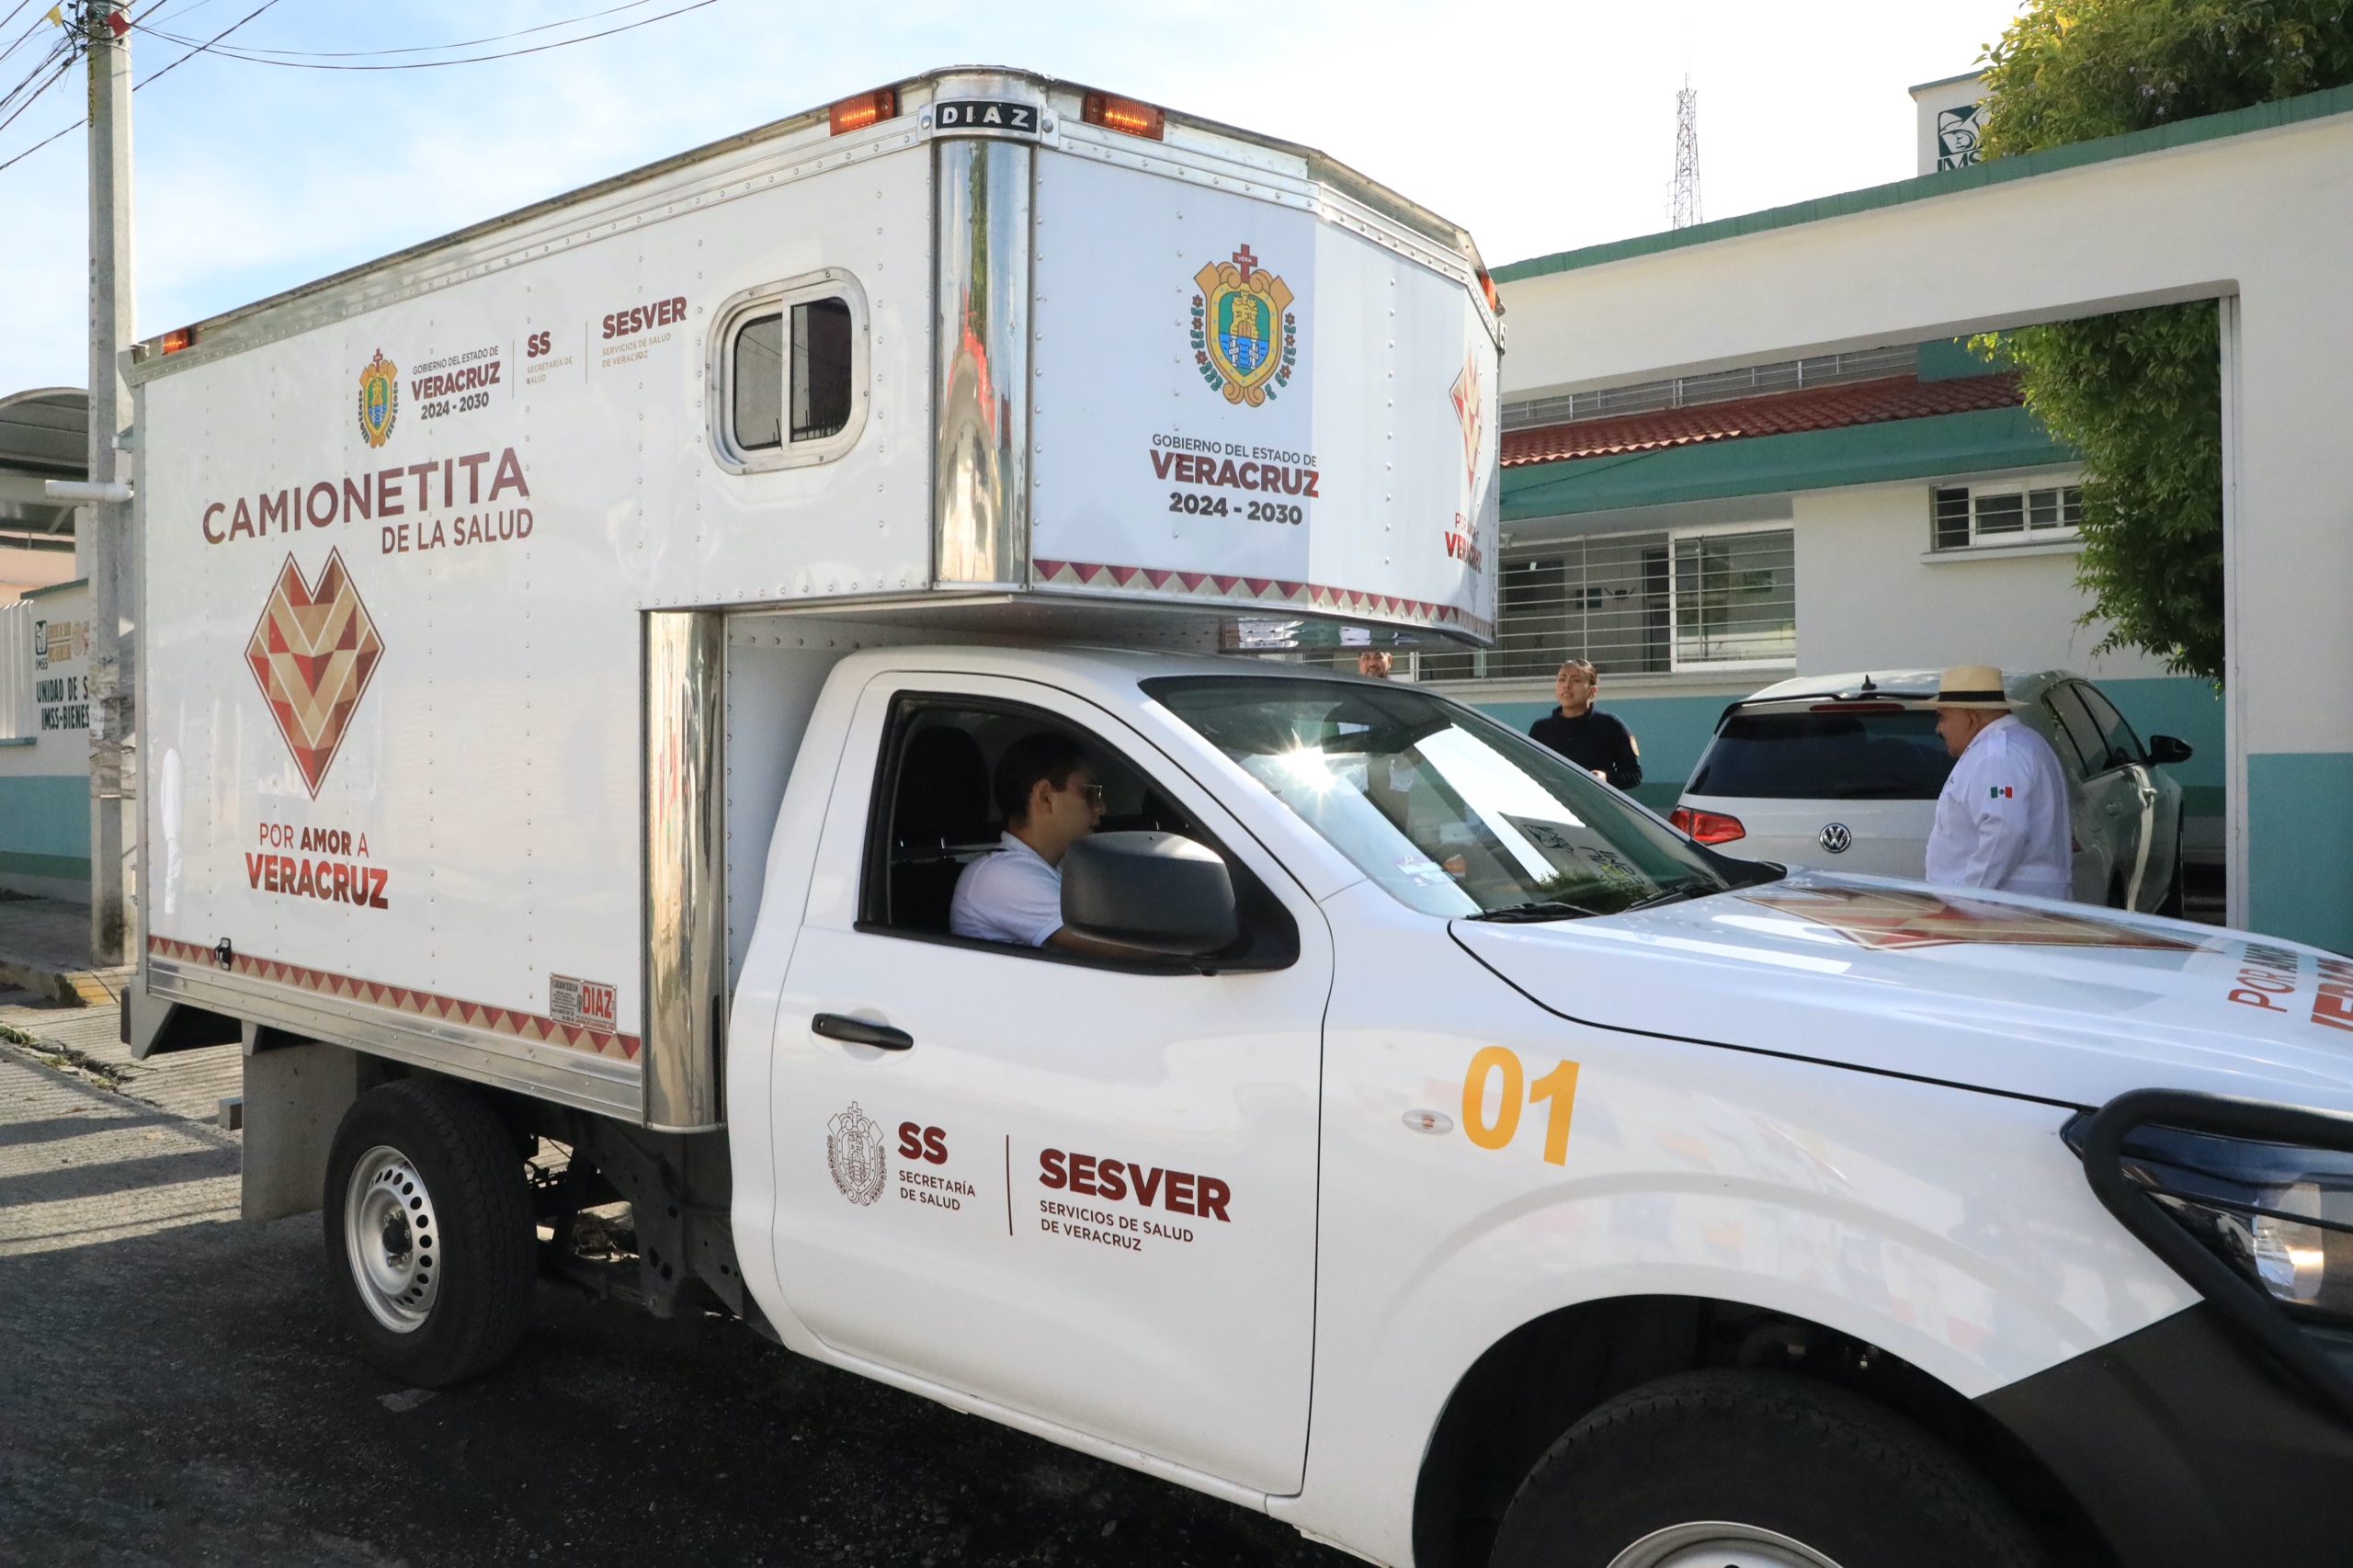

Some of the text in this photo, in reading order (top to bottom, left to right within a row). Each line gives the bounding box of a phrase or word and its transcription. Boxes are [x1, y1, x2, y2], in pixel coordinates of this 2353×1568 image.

[942, 106, 1029, 128] DIAZ
[1237, 256, 1252, 264] VERA
[601, 296, 688, 340] SESVER
[413, 346, 499, 375] GOBIERNO DEL ESTADO DE
[527, 331, 551, 358] SS
[602, 333, 671, 357] SERVICIOS DE SALUD
[602, 350, 648, 369] DE VERACRUZ
[411, 360, 501, 402] VERACRUZ
[527, 356, 573, 374] SECRETARÍA DE
[421, 400, 449, 420] 2024
[459, 392, 489, 413] 2030
[1152, 433, 1317, 468] GOBIERNO DEL ESTADO DE
[1149, 449, 1319, 498] VERACRUZ
[202, 447, 530, 545] CAMIONETITA
[1168, 492, 1228, 517] 2024
[1247, 500, 1303, 526] 2030
[381, 508, 533, 554] DE LA SALUD
[36, 678, 63, 703] UNIDAD
[68, 676, 77, 701] DE
[260, 823, 369, 858] POR AMOR A
[244, 851, 389, 910] VERACRUZ
[582, 985, 612, 1019] DIAZ
[2227, 968, 2297, 1013] POR
[1461, 1045, 1580, 1166] 01
[898, 1121, 948, 1165] SS
[899, 1170, 976, 1197] SECRETARÍA
[900, 1187, 961, 1210] DE SALUD
[1039, 1148, 1231, 1222] SESVER
[1040, 1200, 1194, 1242] SERVICIOS DE SALUD
[1041, 1218, 1142, 1252] DE VERACRUZ
